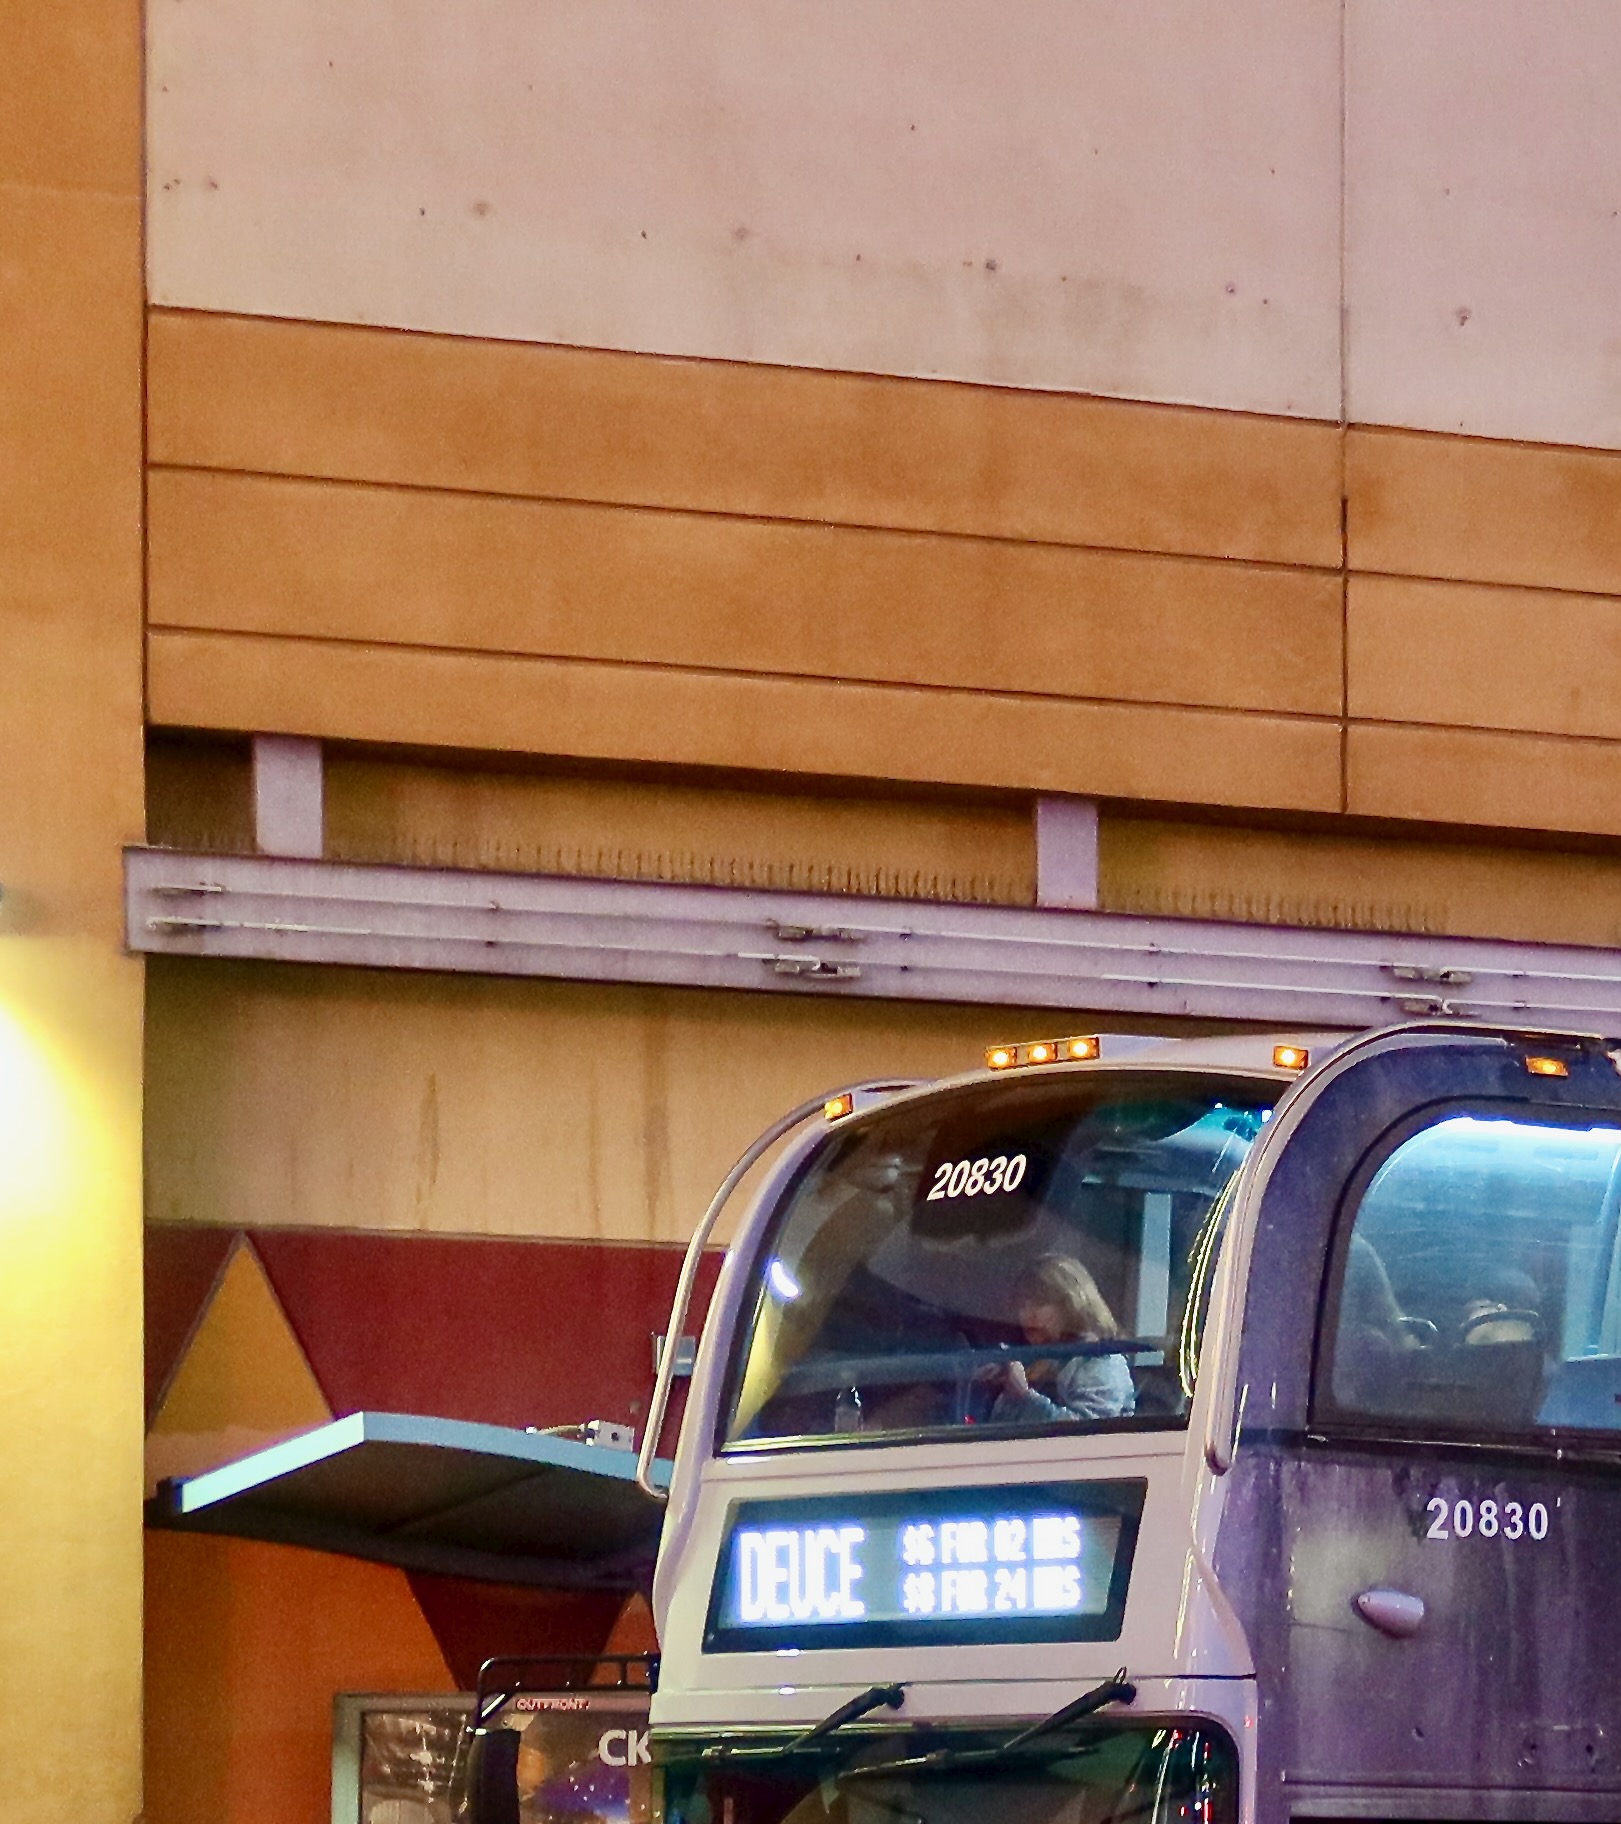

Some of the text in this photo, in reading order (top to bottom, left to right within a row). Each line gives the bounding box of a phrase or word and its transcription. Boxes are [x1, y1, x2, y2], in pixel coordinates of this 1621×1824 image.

[927, 1153, 1027, 1201] 20830
[1426, 1498, 1549, 1540] 20830
[740, 1527, 866, 1621] DEUCE
